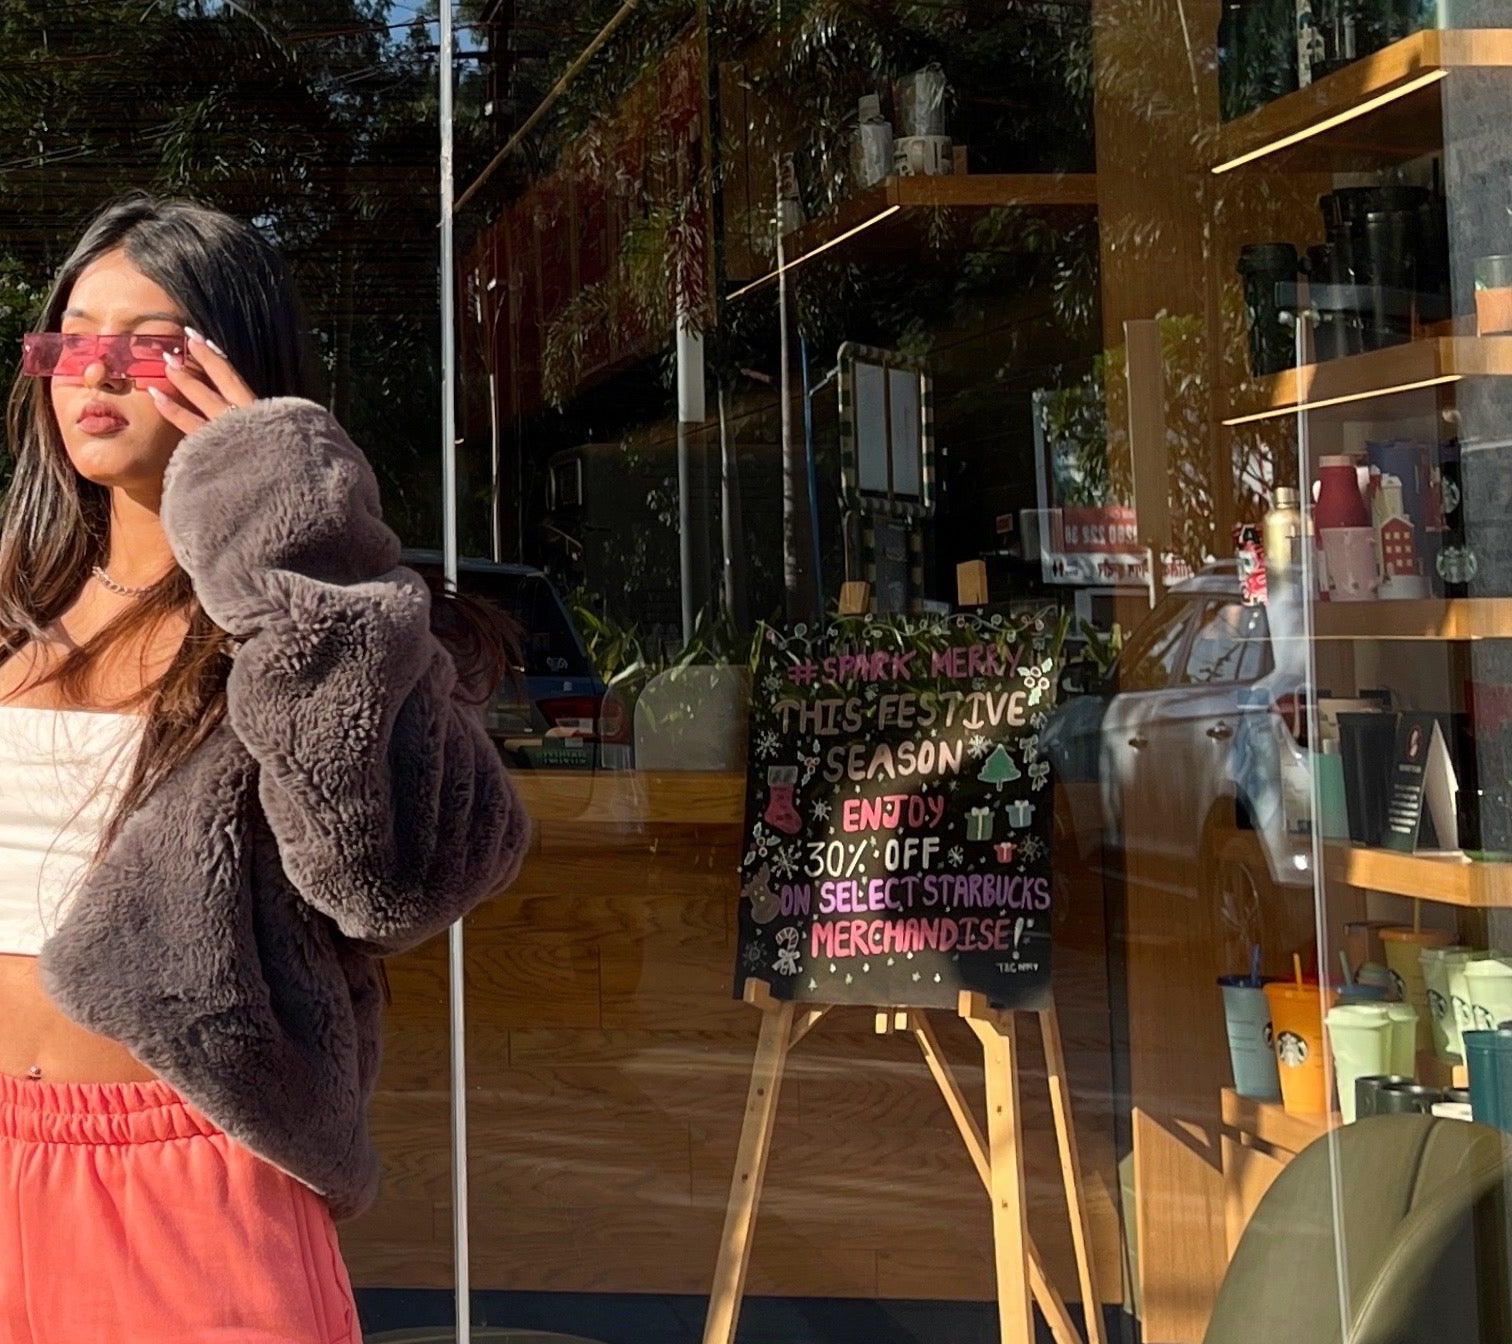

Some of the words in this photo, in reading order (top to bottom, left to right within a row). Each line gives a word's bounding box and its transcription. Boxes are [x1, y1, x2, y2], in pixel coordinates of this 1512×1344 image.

[930, 644, 1025, 679] MERRY
[772, 697, 863, 736] THIS
[878, 691, 1027, 731] FESTIVE
[823, 739, 963, 783] SEASON
[842, 793, 945, 833] ENJOY
[804, 838, 868, 878] 30%
[884, 837, 941, 872] OFF
[779, 883, 811, 916] ON
[819, 876, 920, 914] SELECT
[922, 874, 1051, 910] STARBUCKS
